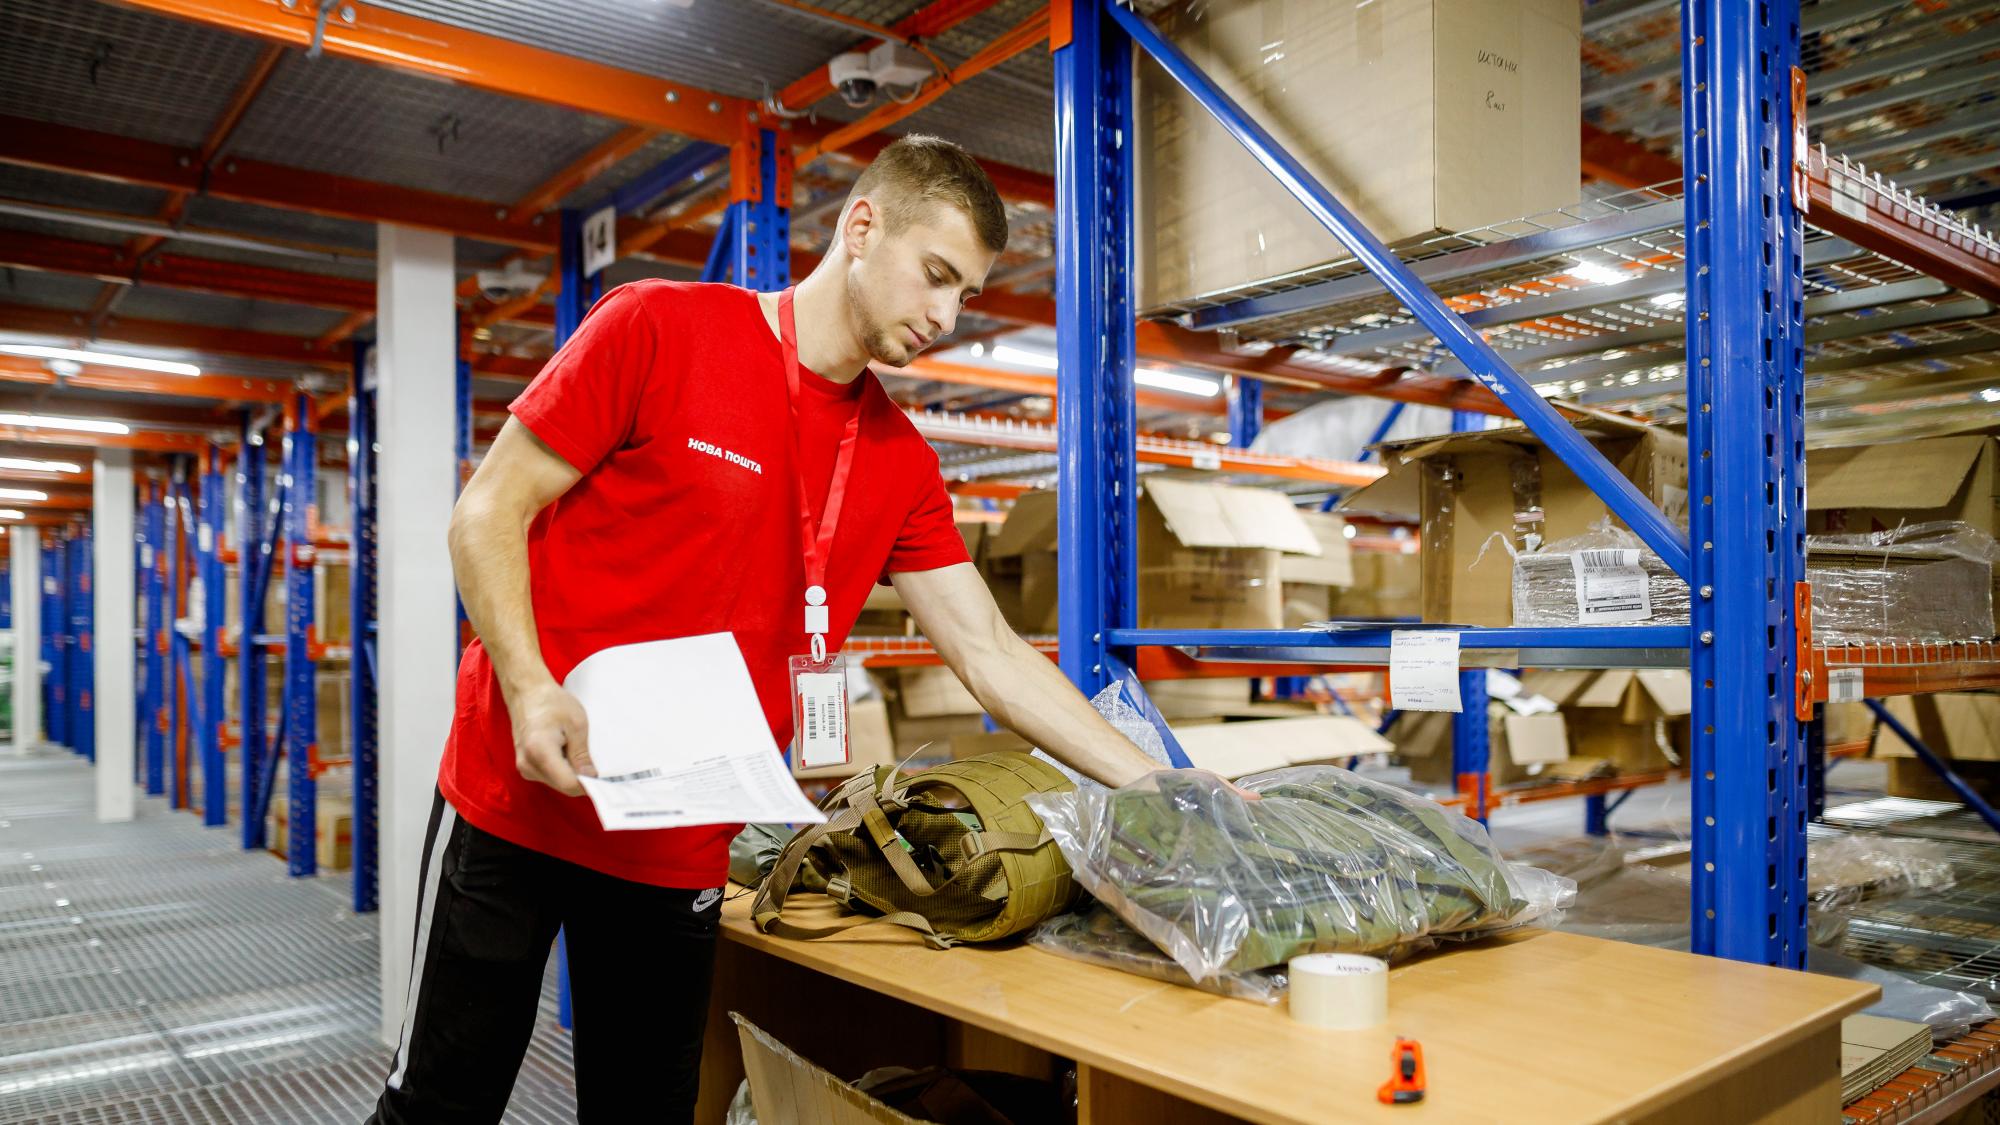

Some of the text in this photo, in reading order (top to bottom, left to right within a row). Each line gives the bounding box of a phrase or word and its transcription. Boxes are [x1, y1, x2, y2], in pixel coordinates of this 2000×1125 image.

[587, 221, 607, 258] 14
[687, 438, 762, 475] НОВА ПОШТА
